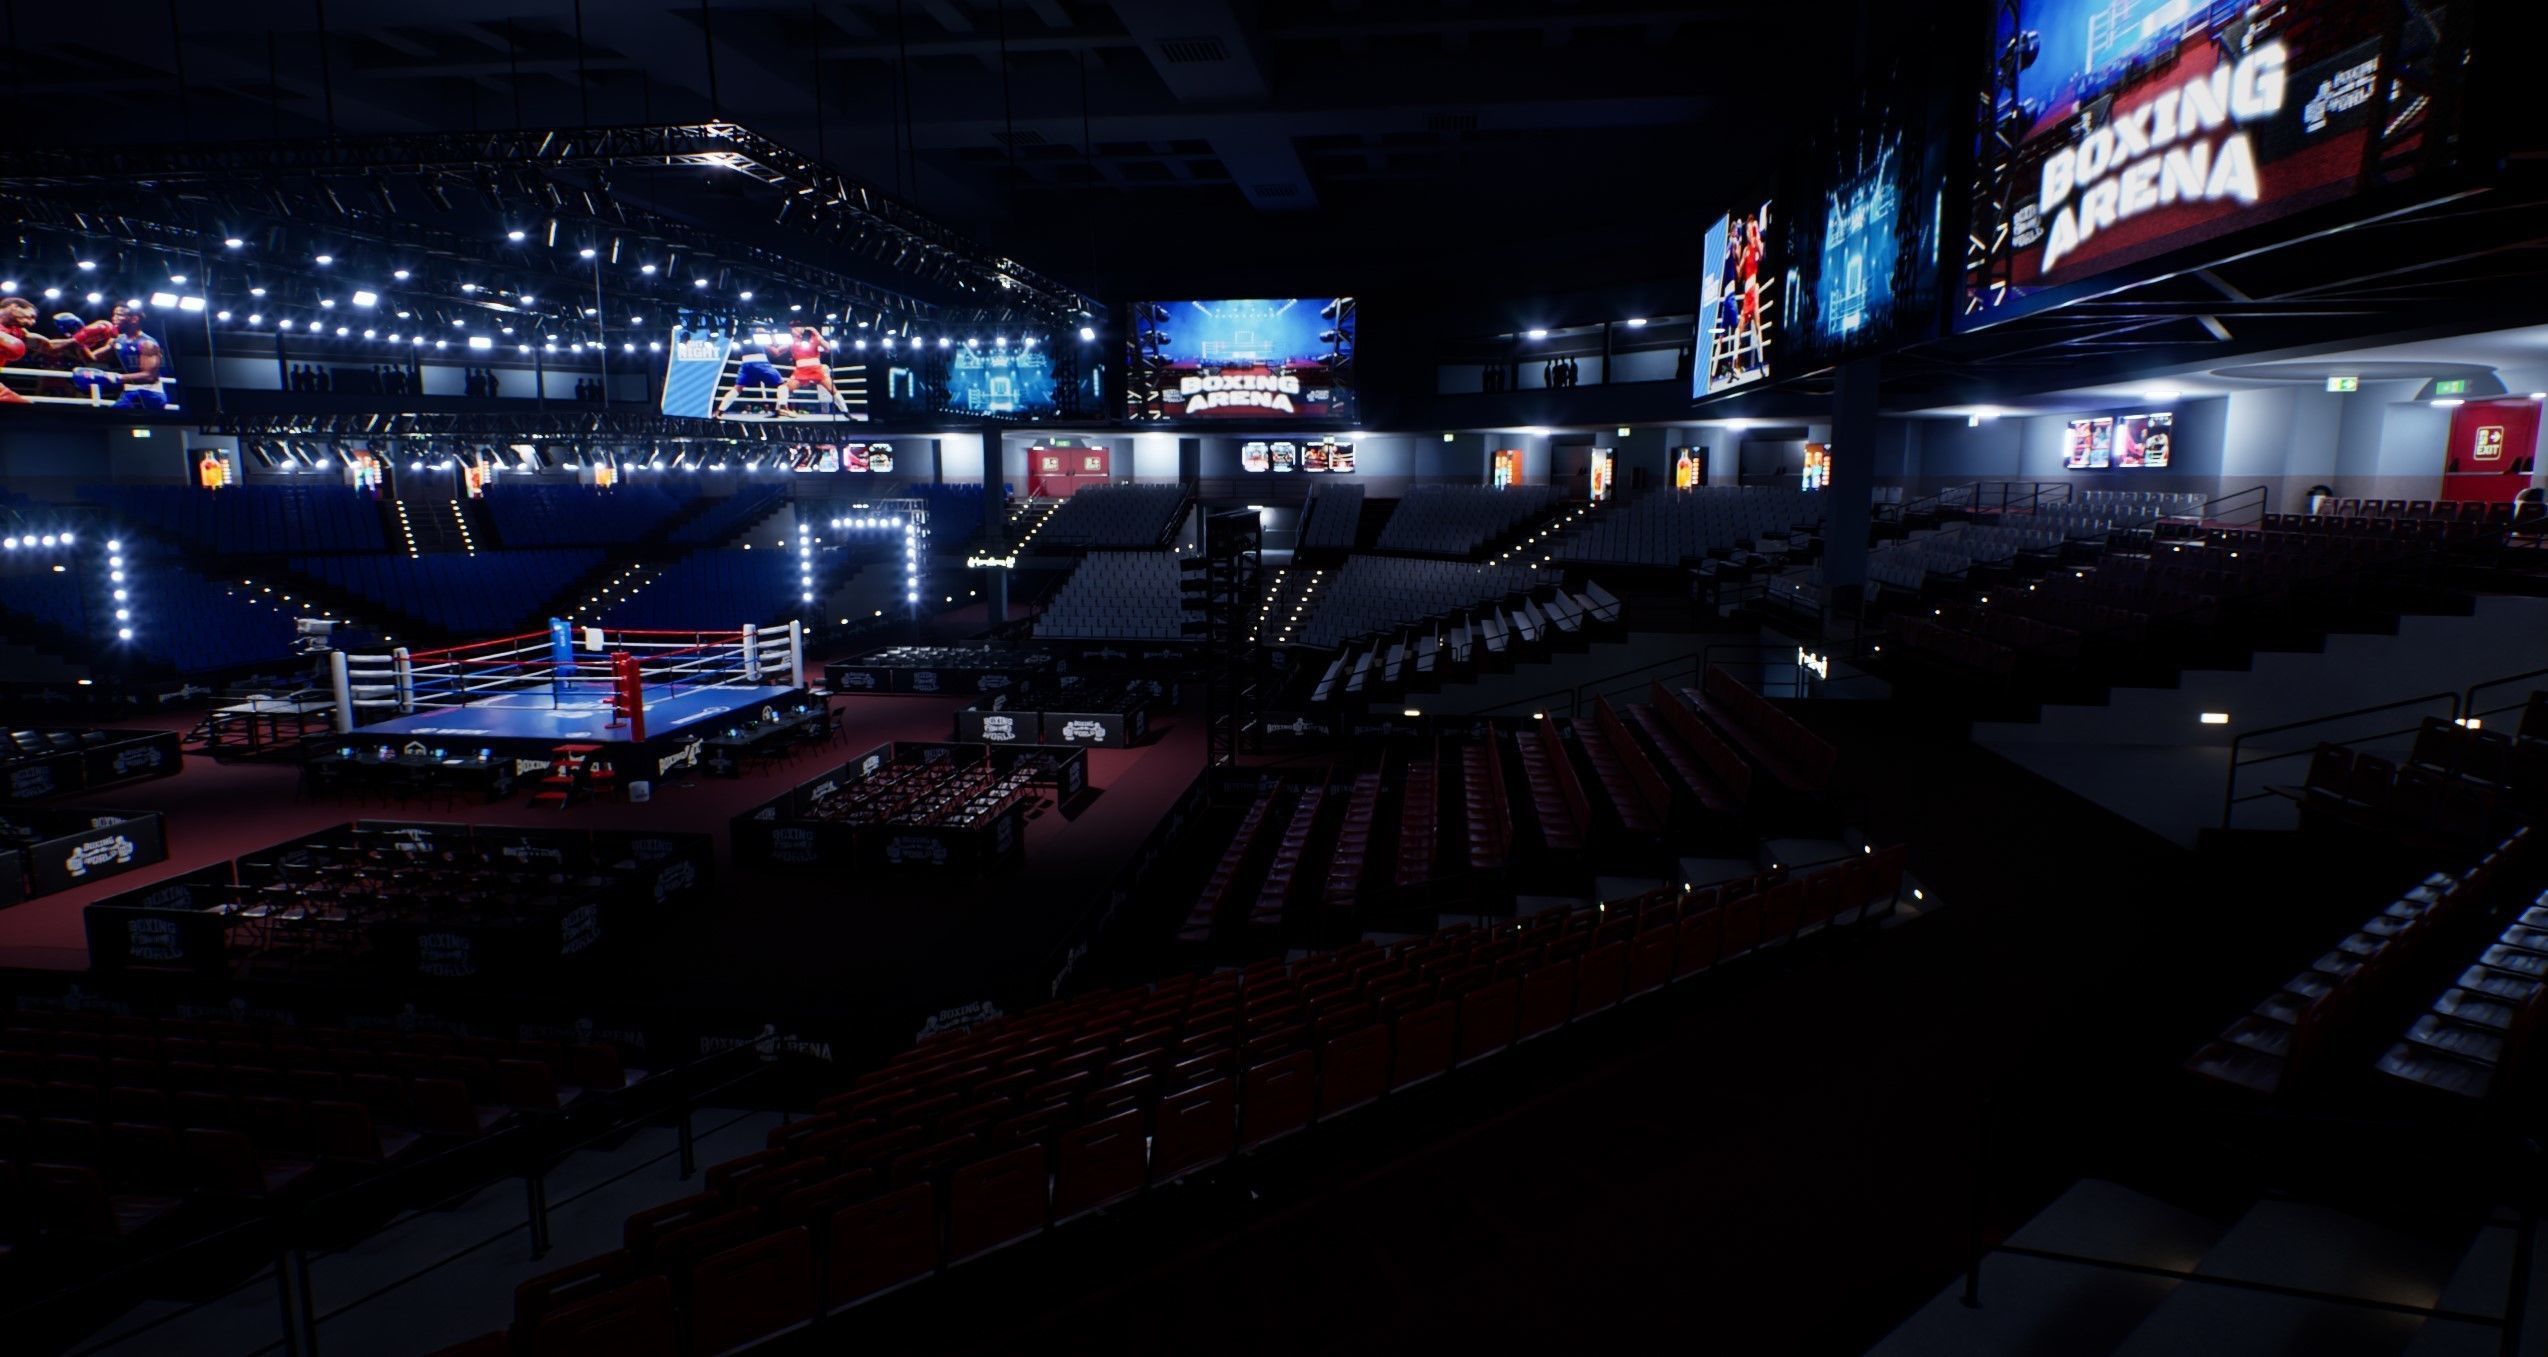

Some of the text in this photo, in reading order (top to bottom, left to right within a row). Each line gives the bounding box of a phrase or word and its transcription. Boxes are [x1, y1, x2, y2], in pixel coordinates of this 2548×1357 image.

[2039, 39, 2289, 216] BOXING
[2040, 131, 2260, 275] ARENA
[1180, 374, 1300, 395] BOXING
[1185, 390, 1295, 414] ARENA
[2476, 444, 2500, 456] EXIT
[938, 1001, 983, 1022] BOXING
